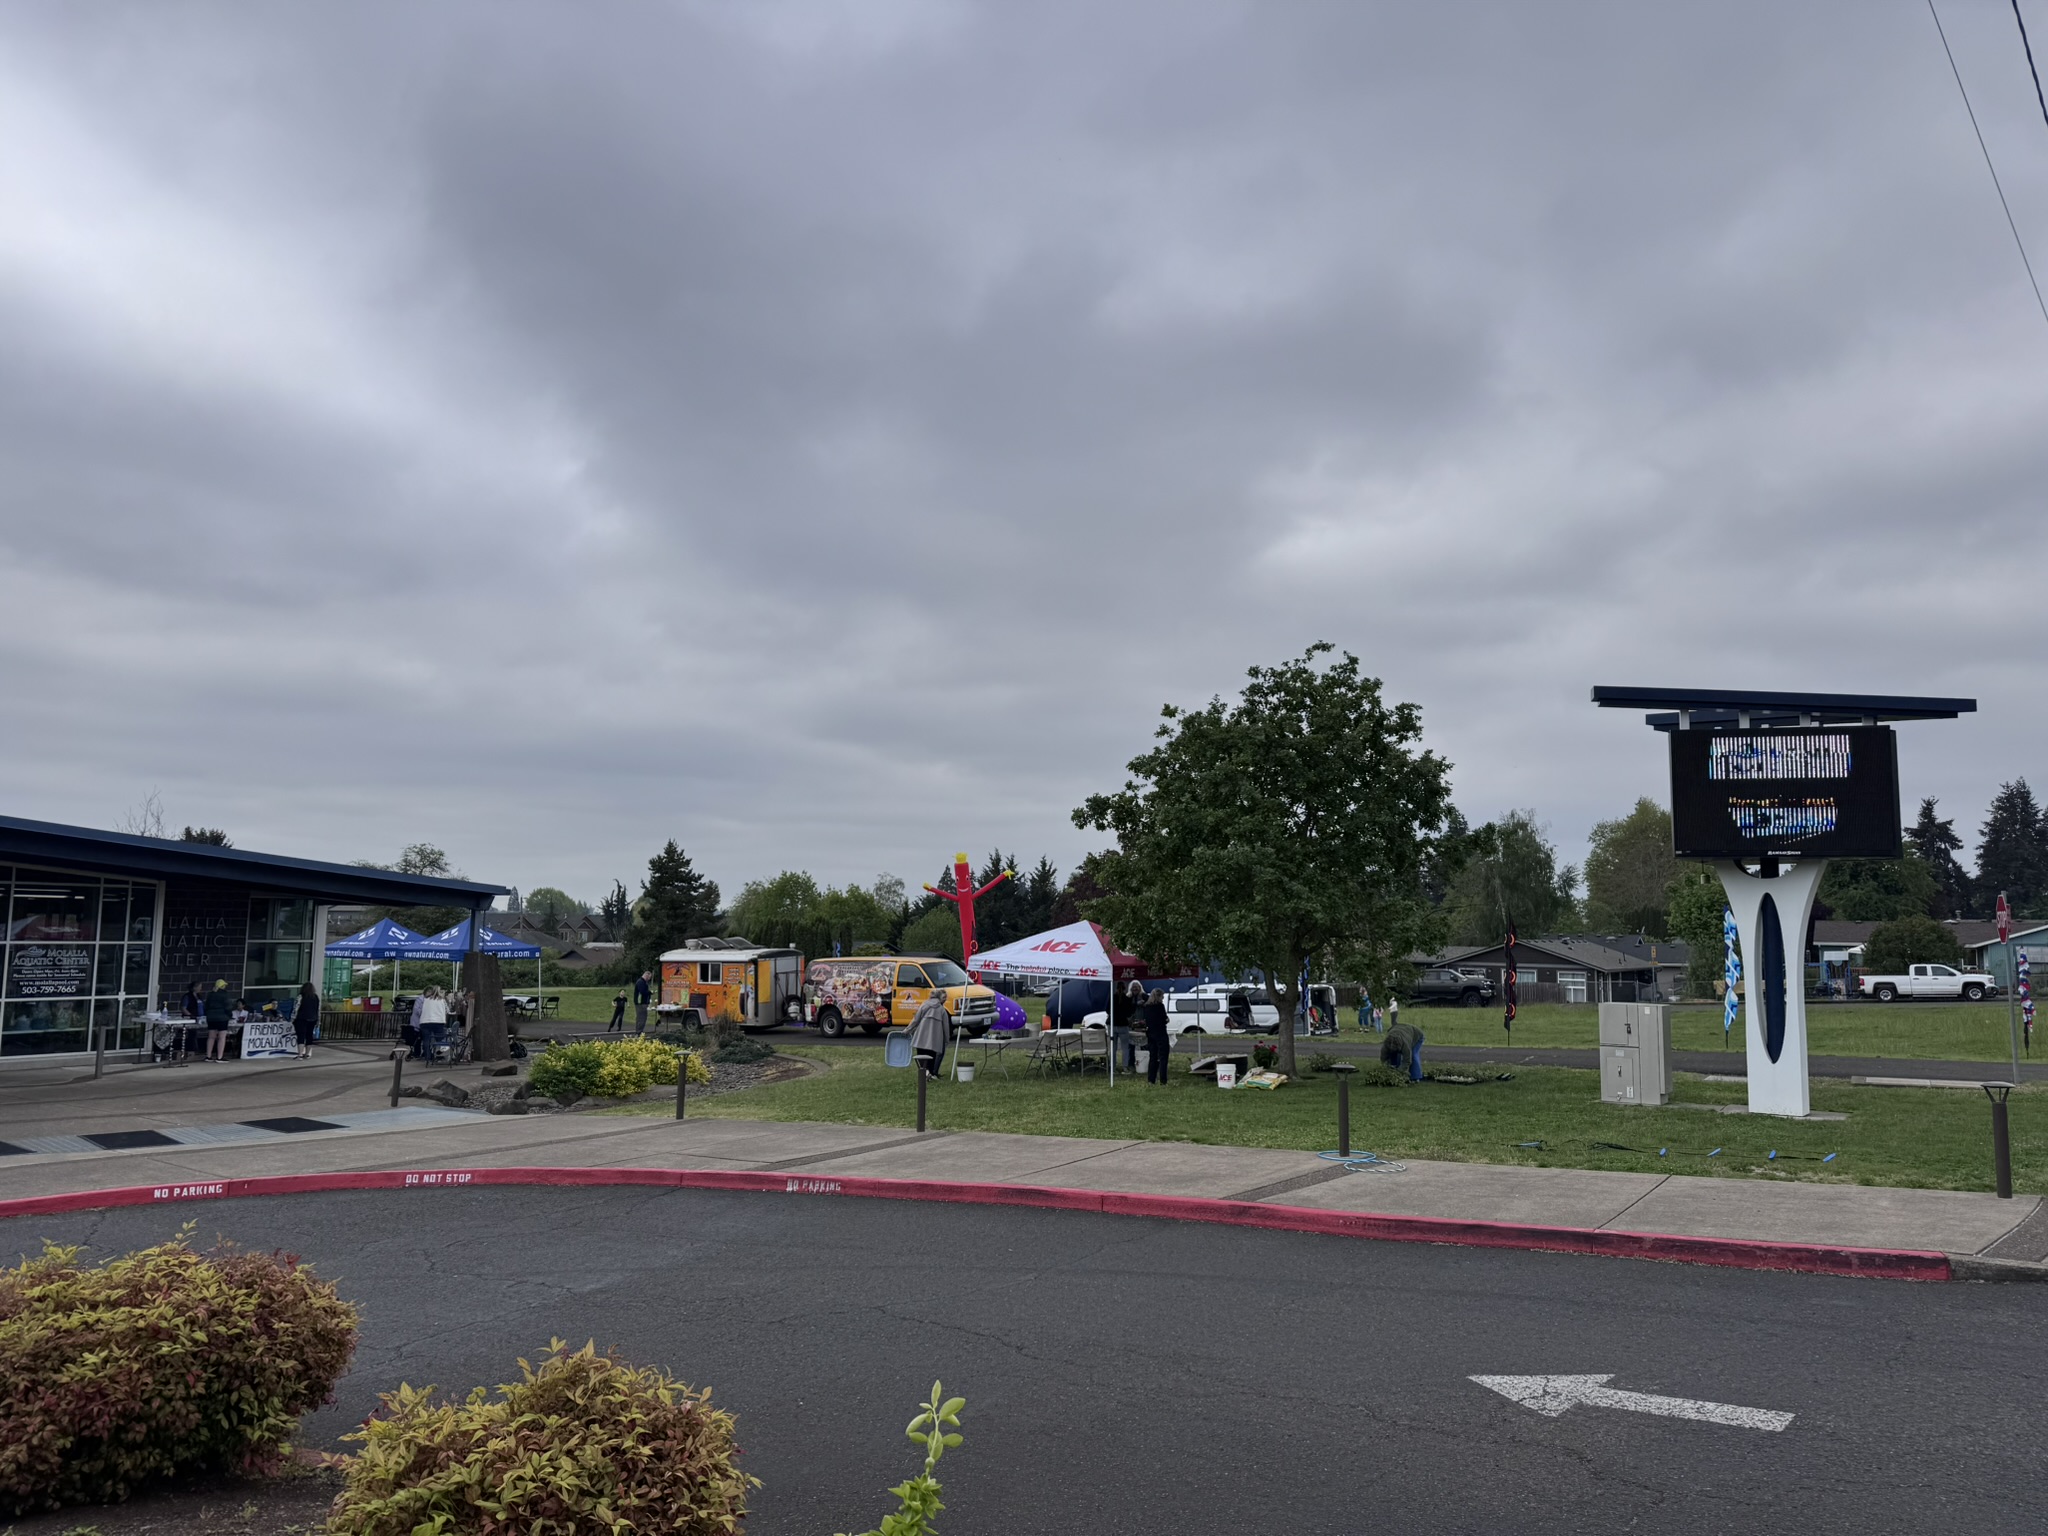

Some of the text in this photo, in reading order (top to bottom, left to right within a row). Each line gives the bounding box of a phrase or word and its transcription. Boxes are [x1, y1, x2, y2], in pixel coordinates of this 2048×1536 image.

[169, 916, 226, 929] LALLA
[163, 935, 225, 948] UATIC
[1029, 938, 1087, 954] ACE
[47, 949, 88, 957] MOLALLA
[160, 952, 210, 967] NTER
[12, 956, 90, 966] AQUATIC CENTER
[981, 959, 1001, 971] ACE
[1020, 963, 1047, 973] helpful
[1075, 966, 1100, 977] ACE
[21, 986, 76, 994] 503-759-7665
[250, 1024, 284, 1036] FRIENDS
[284, 1036, 297, 1048] PO
[405, 1173, 472, 1184] DO NOT STOP
[153, 1179, 223, 1198] NO PARKING
[786, 1179, 841, 1193] NO PARKING
